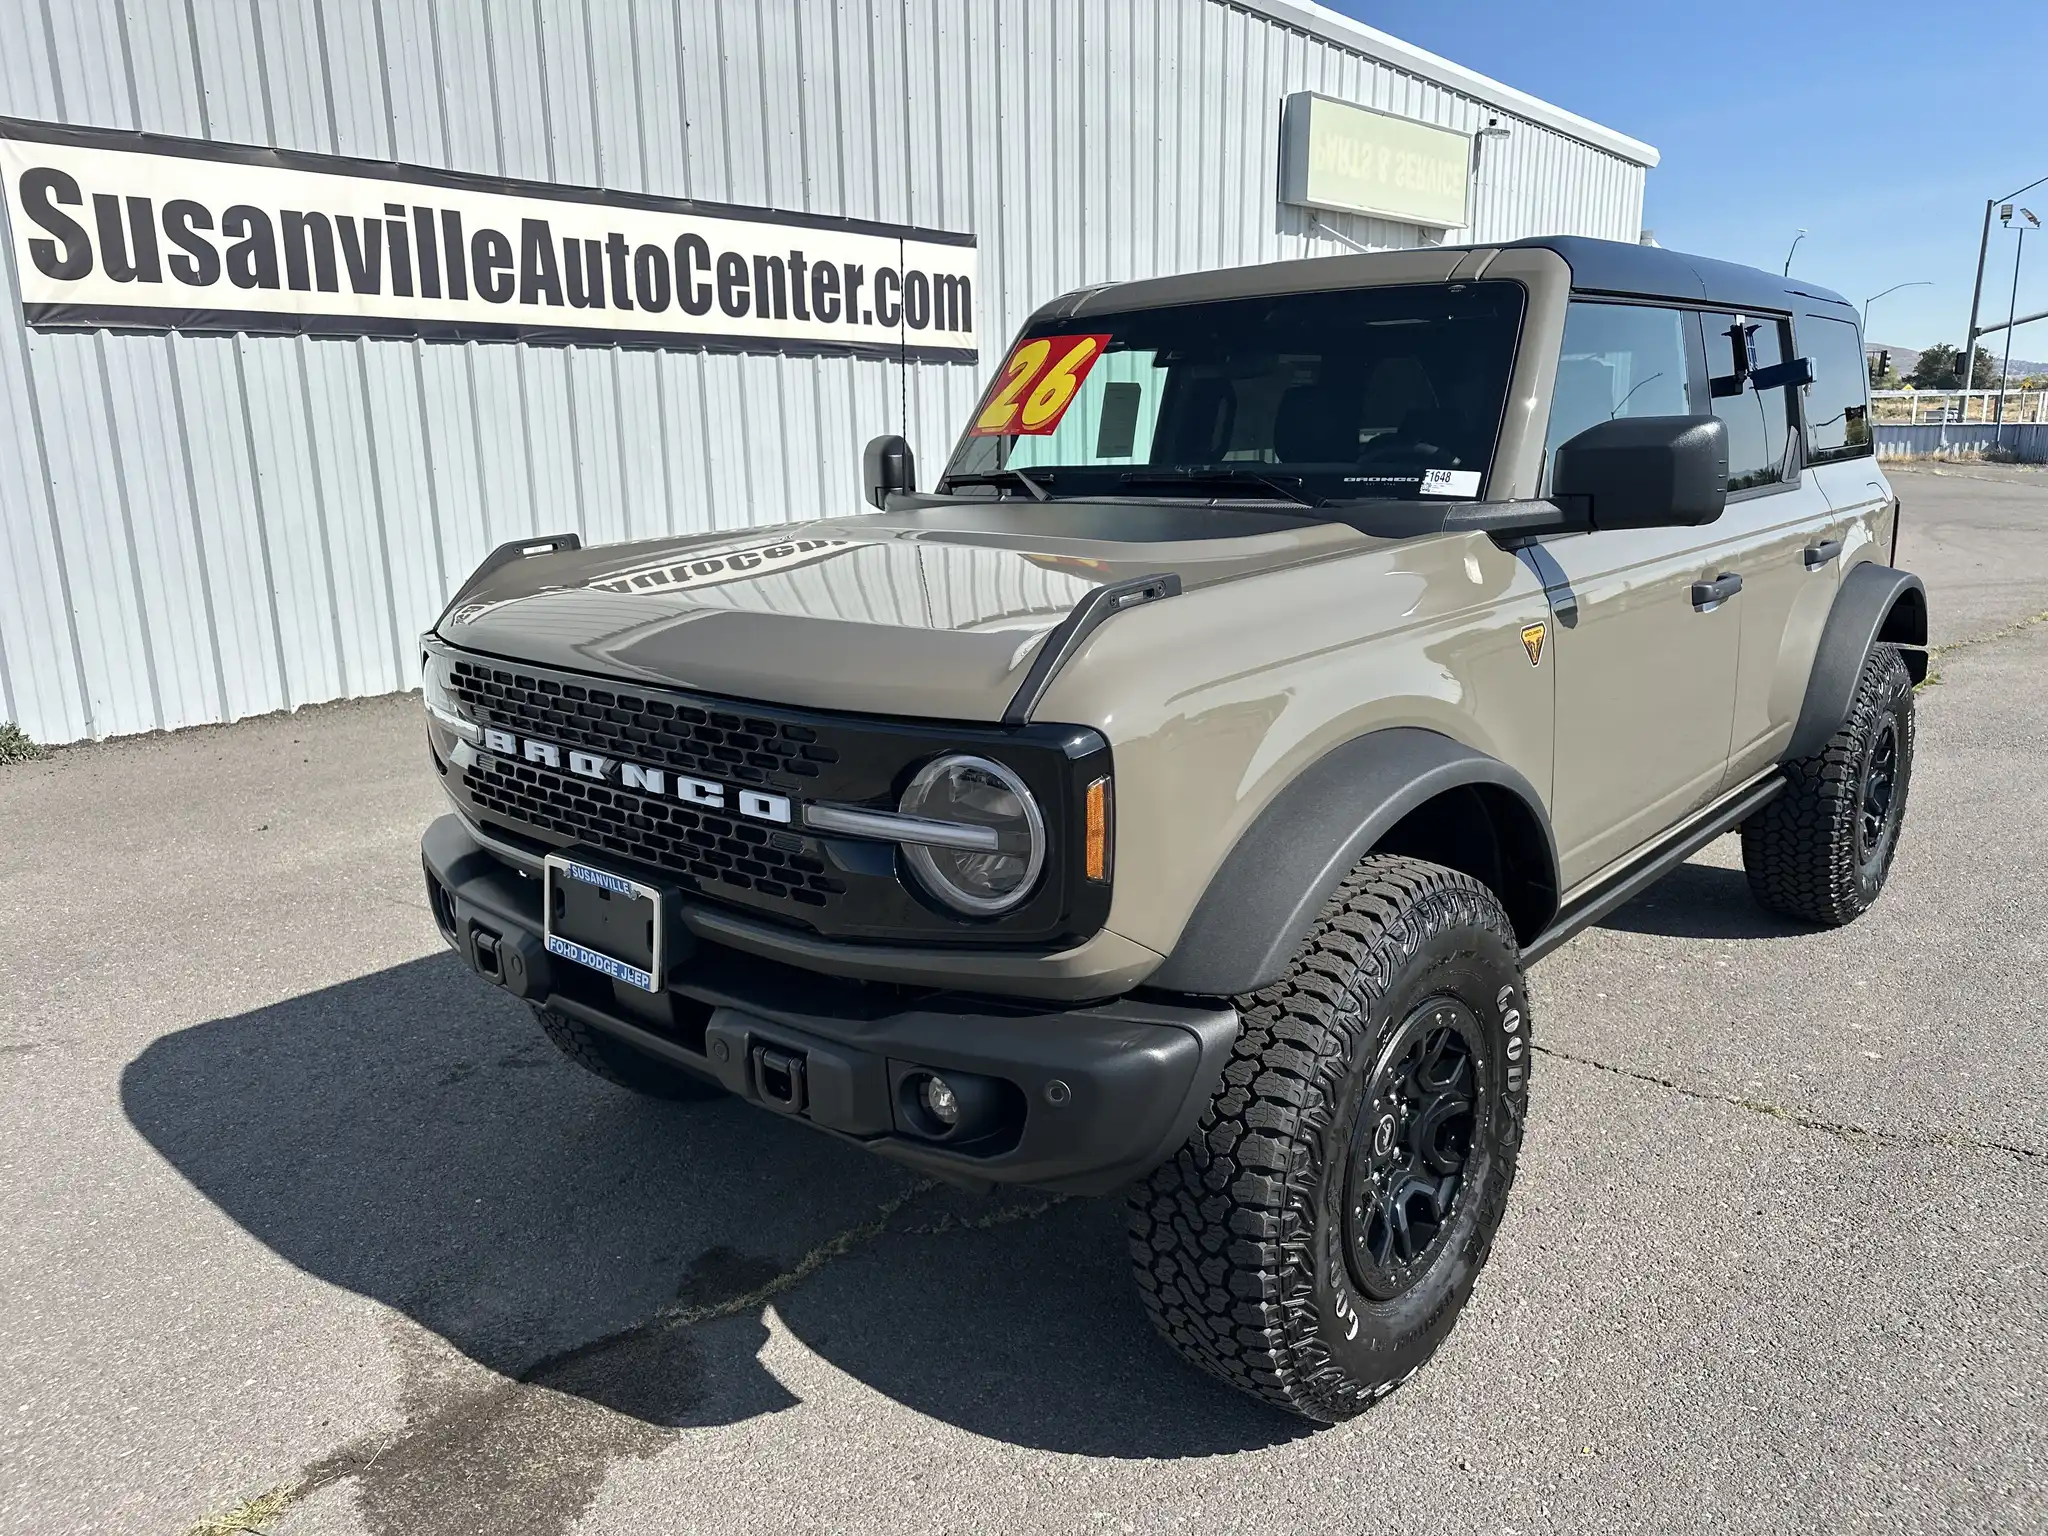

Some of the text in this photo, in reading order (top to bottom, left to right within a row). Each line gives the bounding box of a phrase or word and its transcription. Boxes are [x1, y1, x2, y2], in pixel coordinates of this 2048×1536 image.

[16, 166, 973, 334] SusanvilleAutoCenter.com
[976, 336, 1097, 431] 26
[484, 727, 792, 824] BRONCO
[571, 865, 630, 894] SUSANVILLE
[550, 937, 650, 987] FORD DODGE JEEP
